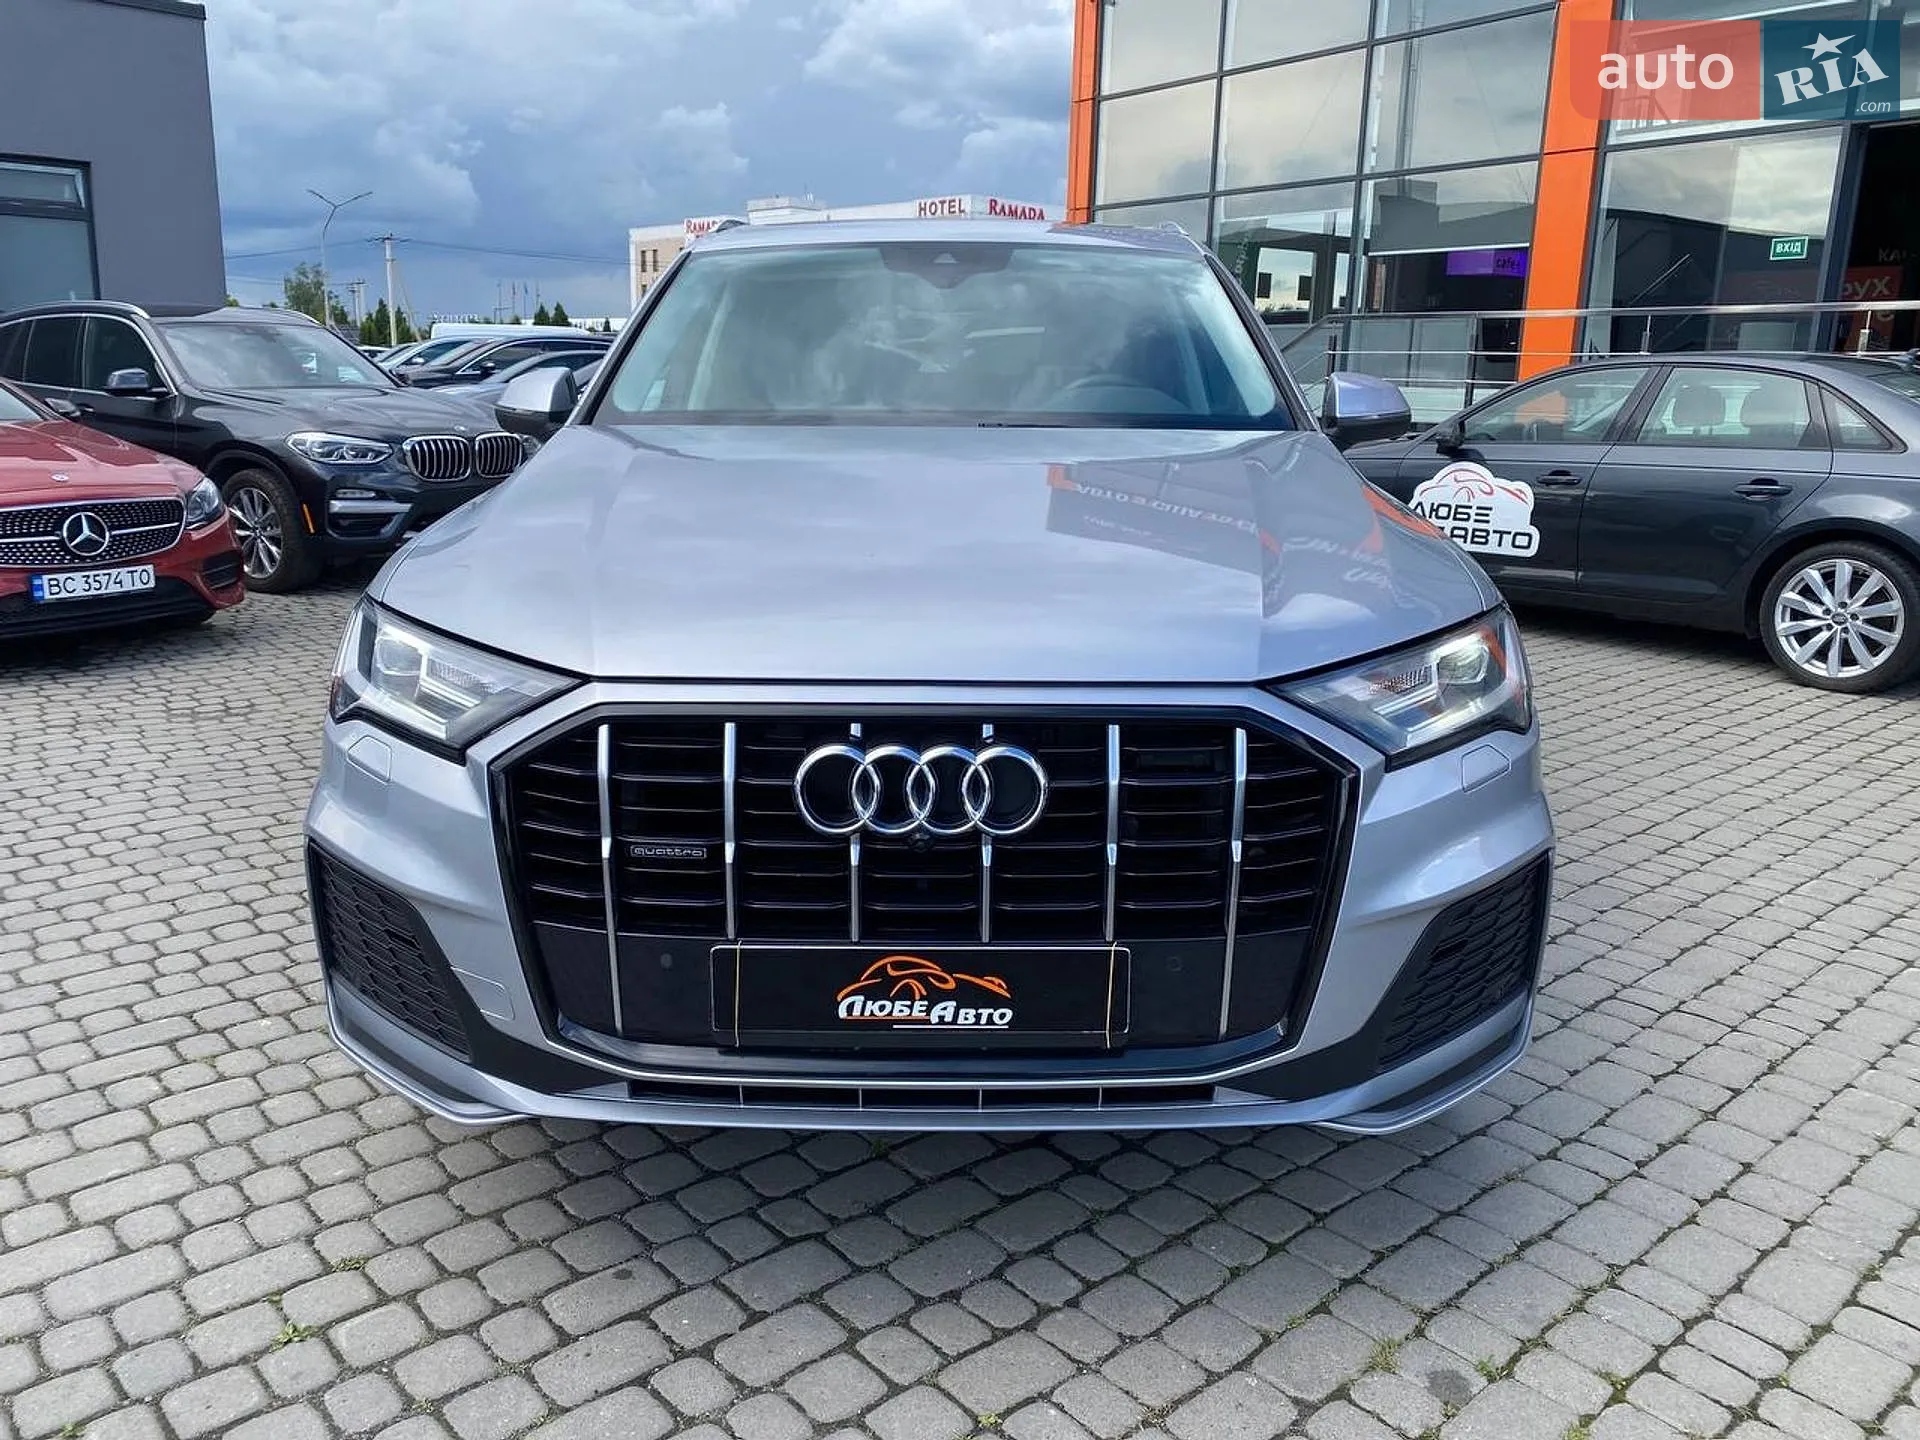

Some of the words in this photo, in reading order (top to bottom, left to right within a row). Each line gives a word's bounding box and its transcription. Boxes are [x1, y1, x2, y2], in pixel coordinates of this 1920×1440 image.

[918, 199, 966, 217] HOTEL
[988, 198, 1046, 221] RAMADA
[1776, 242, 1802, 254] ВХІД
[1413, 501, 1494, 524] ЛЮБЕ
[1450, 526, 1533, 550] АВТО
[48, 576, 77, 596] BC
[81, 571, 123, 592] 3574
[127, 568, 150, 587] TO
[634, 847, 703, 857] quattro
